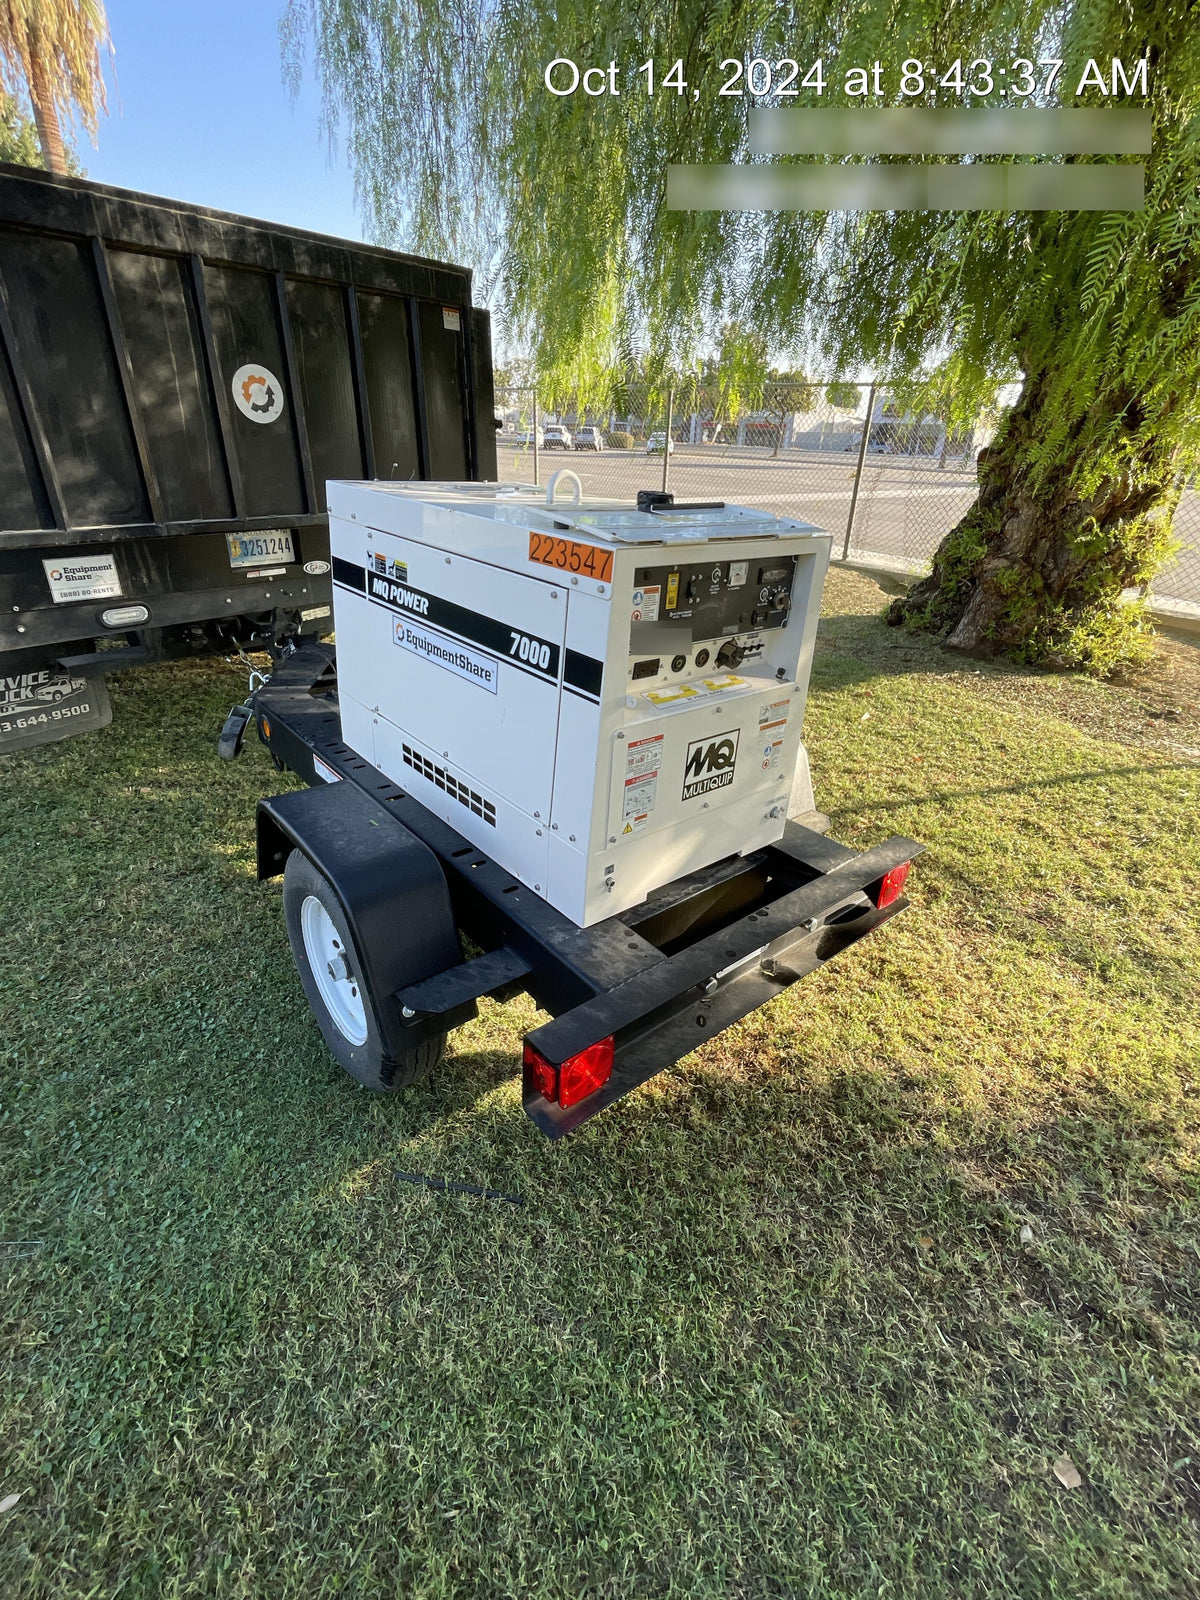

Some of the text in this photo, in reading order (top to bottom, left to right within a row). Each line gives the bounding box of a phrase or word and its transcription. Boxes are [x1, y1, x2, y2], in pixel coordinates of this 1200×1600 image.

[241, 537, 291, 557] 3251244
[530, 534, 612, 580] 223547
[63, 563, 113, 575] Equipment
[65, 574, 92, 582] Share
[373, 578, 429, 615] MQ POWER
[406, 628, 492, 683] EquipmentShare
[509, 631, 551, 670] 7000
[0, 704, 90, 733] 3-644-9500
[687, 739, 736, 778] MQ
[683, 772, 734, 799] MULTIQUIP
